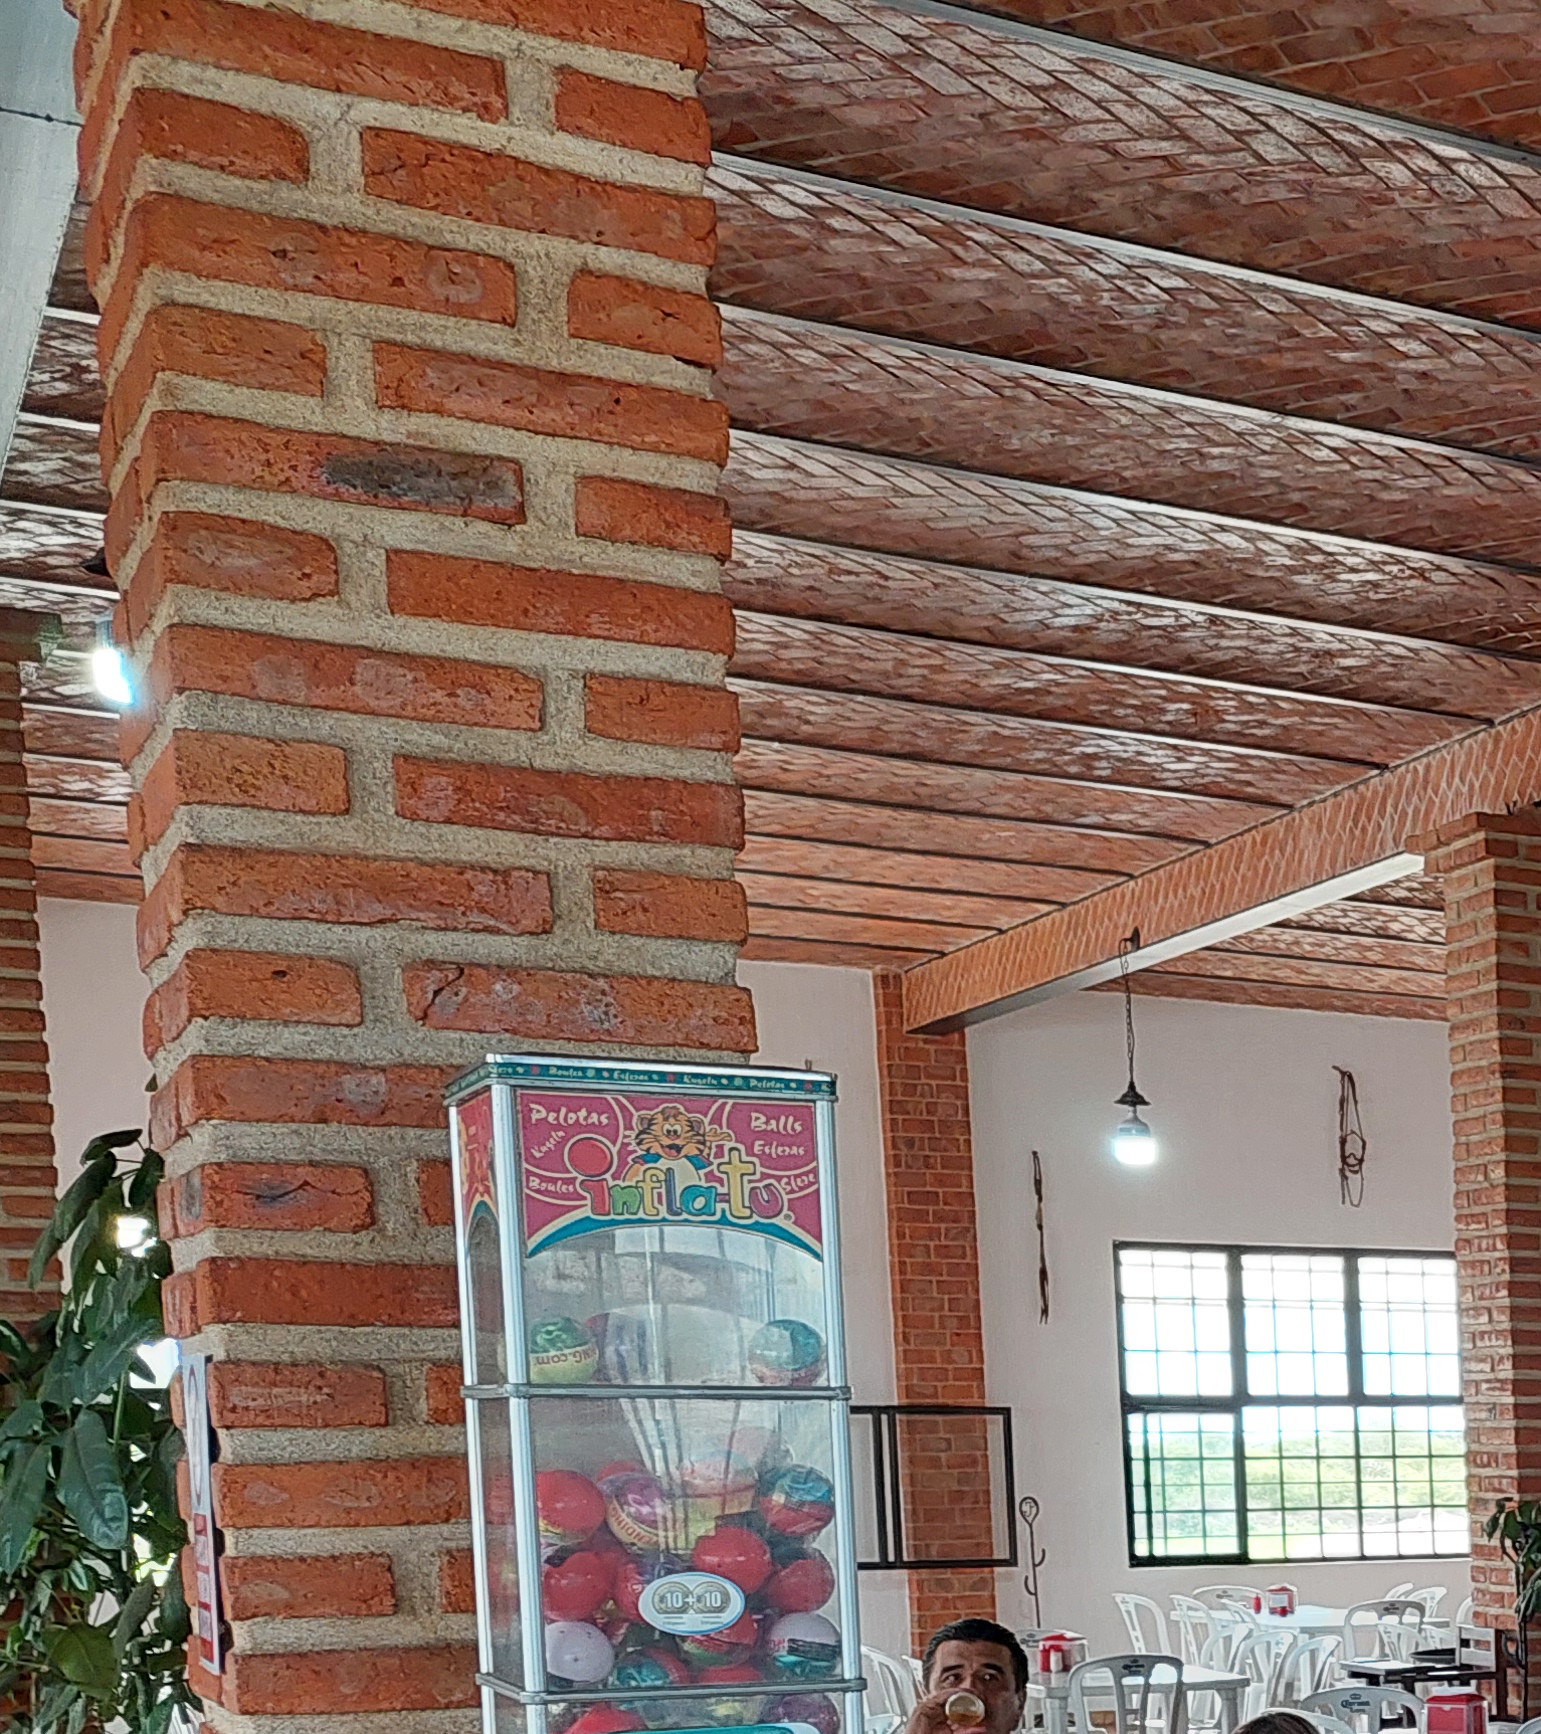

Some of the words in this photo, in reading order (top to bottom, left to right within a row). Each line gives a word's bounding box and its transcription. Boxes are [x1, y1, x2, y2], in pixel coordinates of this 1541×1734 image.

[529, 1103, 610, 1127] Pelotas
[750, 1112, 803, 1135] Balls
[530, 1130, 566, 1158] Kugeln
[528, 1176, 575, 1194] Boules
